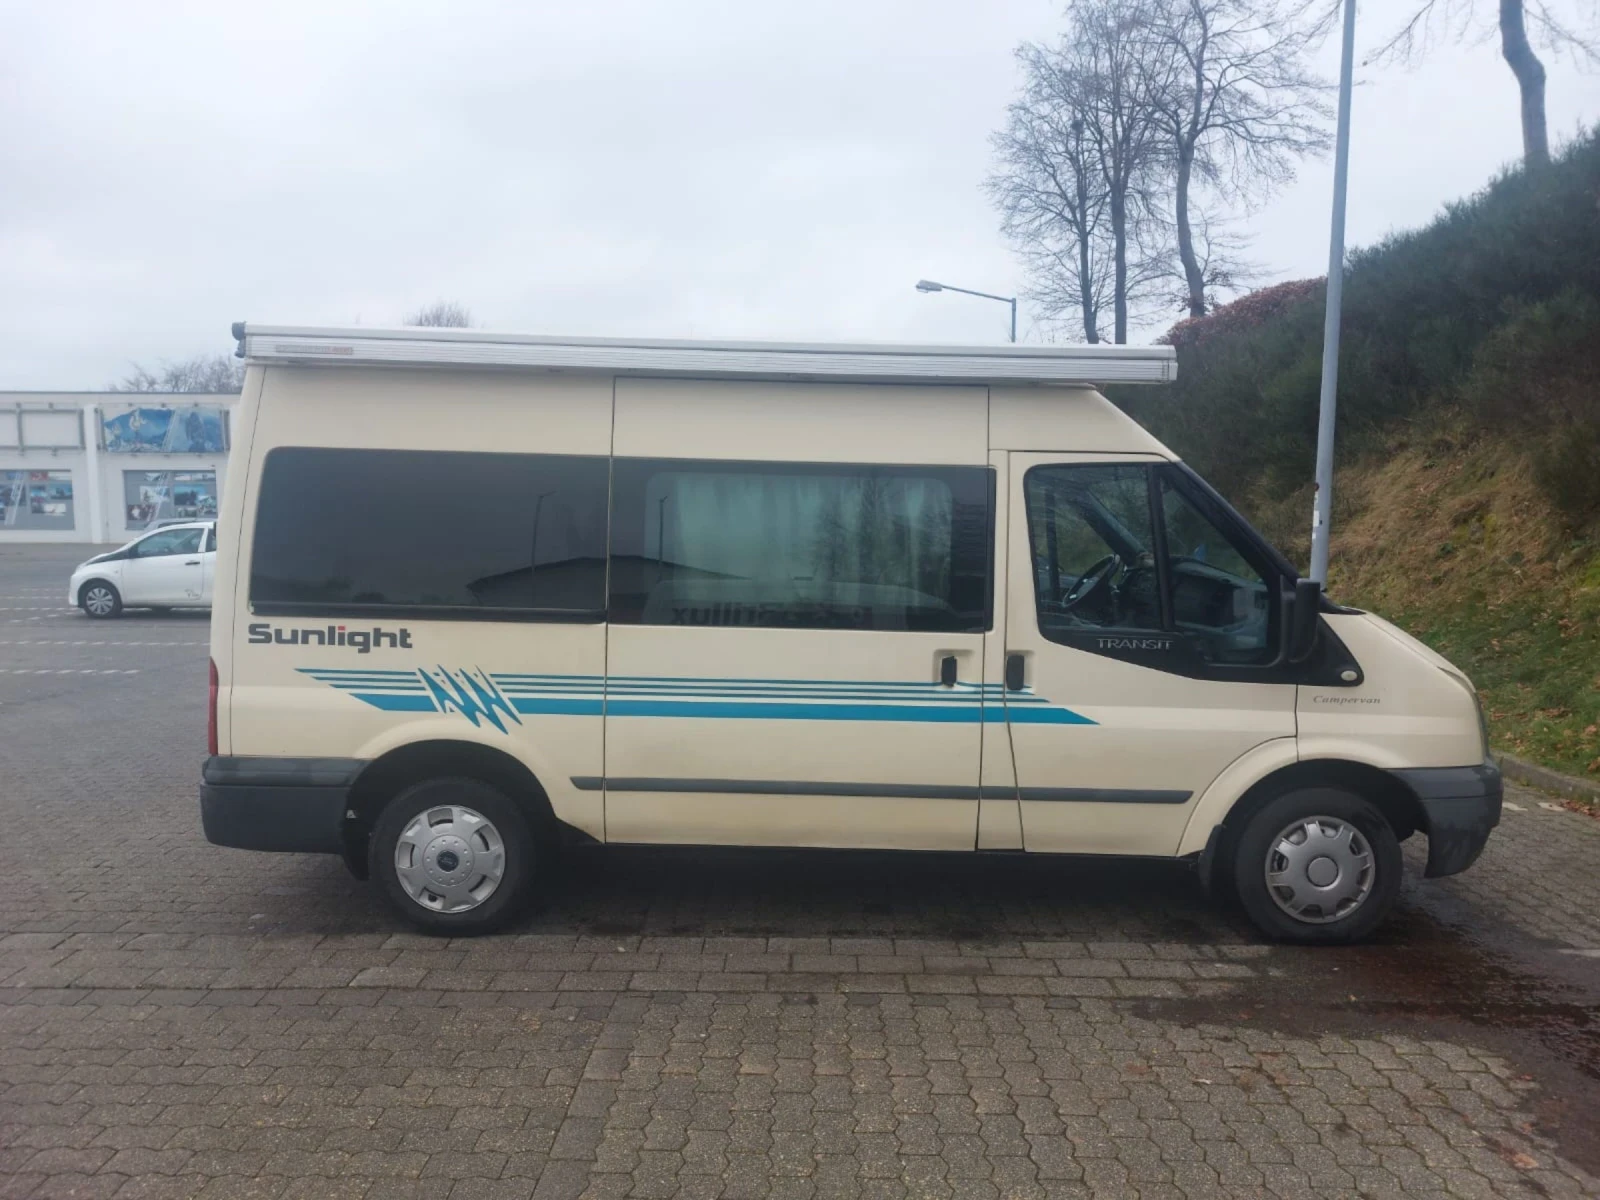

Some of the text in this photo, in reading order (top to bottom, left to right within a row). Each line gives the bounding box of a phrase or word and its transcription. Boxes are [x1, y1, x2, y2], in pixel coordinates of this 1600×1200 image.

[248, 624, 413, 654] Sunlight
[1096, 638, 1174, 650] TRANSIT
[1313, 695, 1381, 705] Campervan
